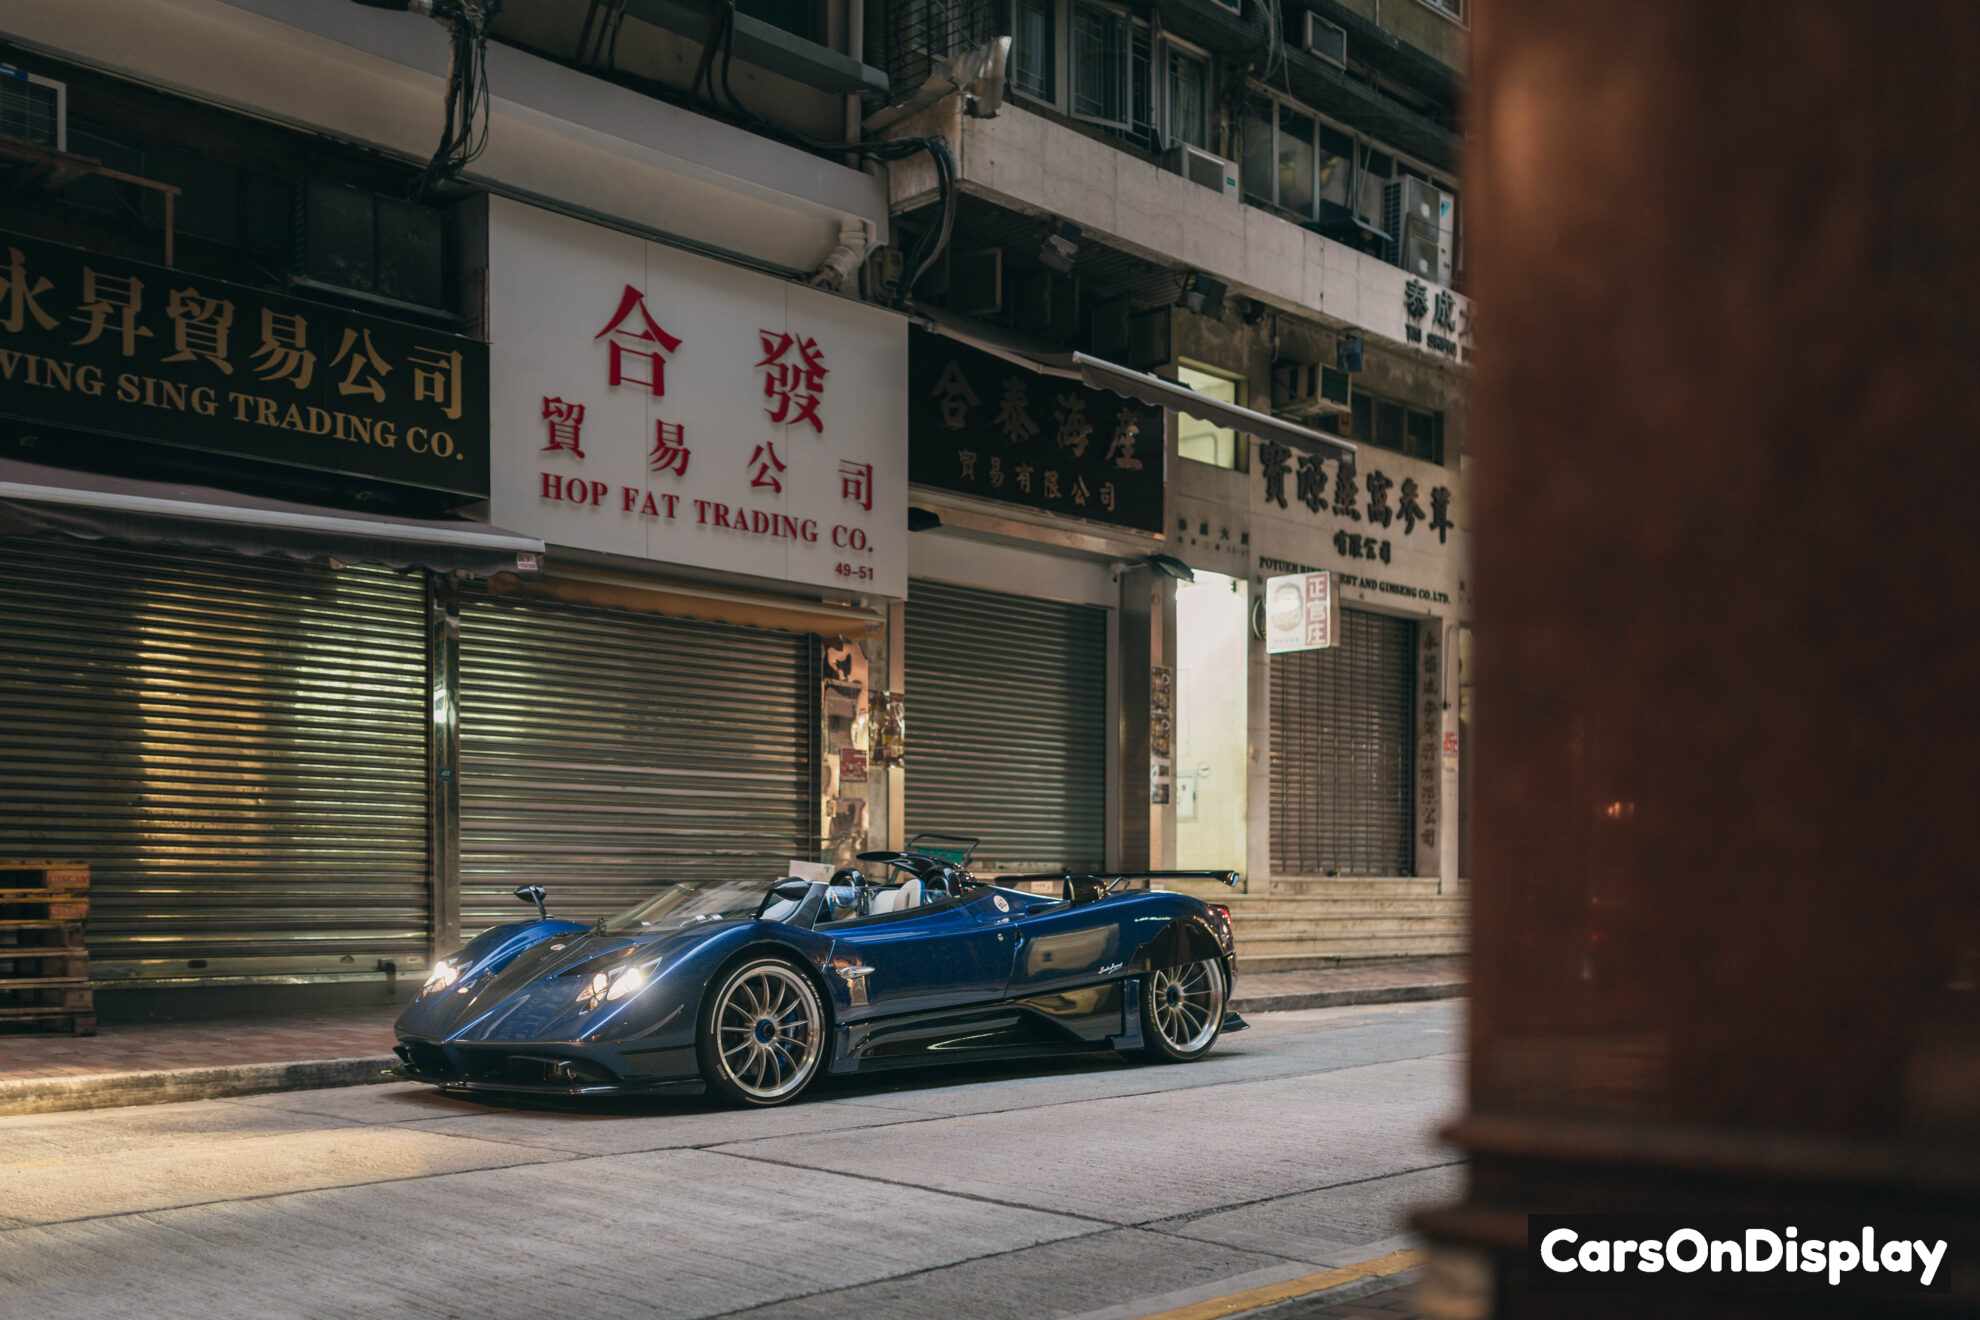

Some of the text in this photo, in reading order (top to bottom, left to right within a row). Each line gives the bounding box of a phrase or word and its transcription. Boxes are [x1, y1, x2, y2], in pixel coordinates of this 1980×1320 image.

[594, 283, 831, 434] 合發
[116, 373, 218, 416] SING
[228, 391, 399, 449] TRADING
[405, 426, 465, 460] CO.
[540, 396, 875, 512] 貿易公司
[540, 472, 874, 553] HOP FAT TRADING CO.
[957, 448, 1117, 512] 貿易有限公司
[1359, 577, 1378, 592] AND
